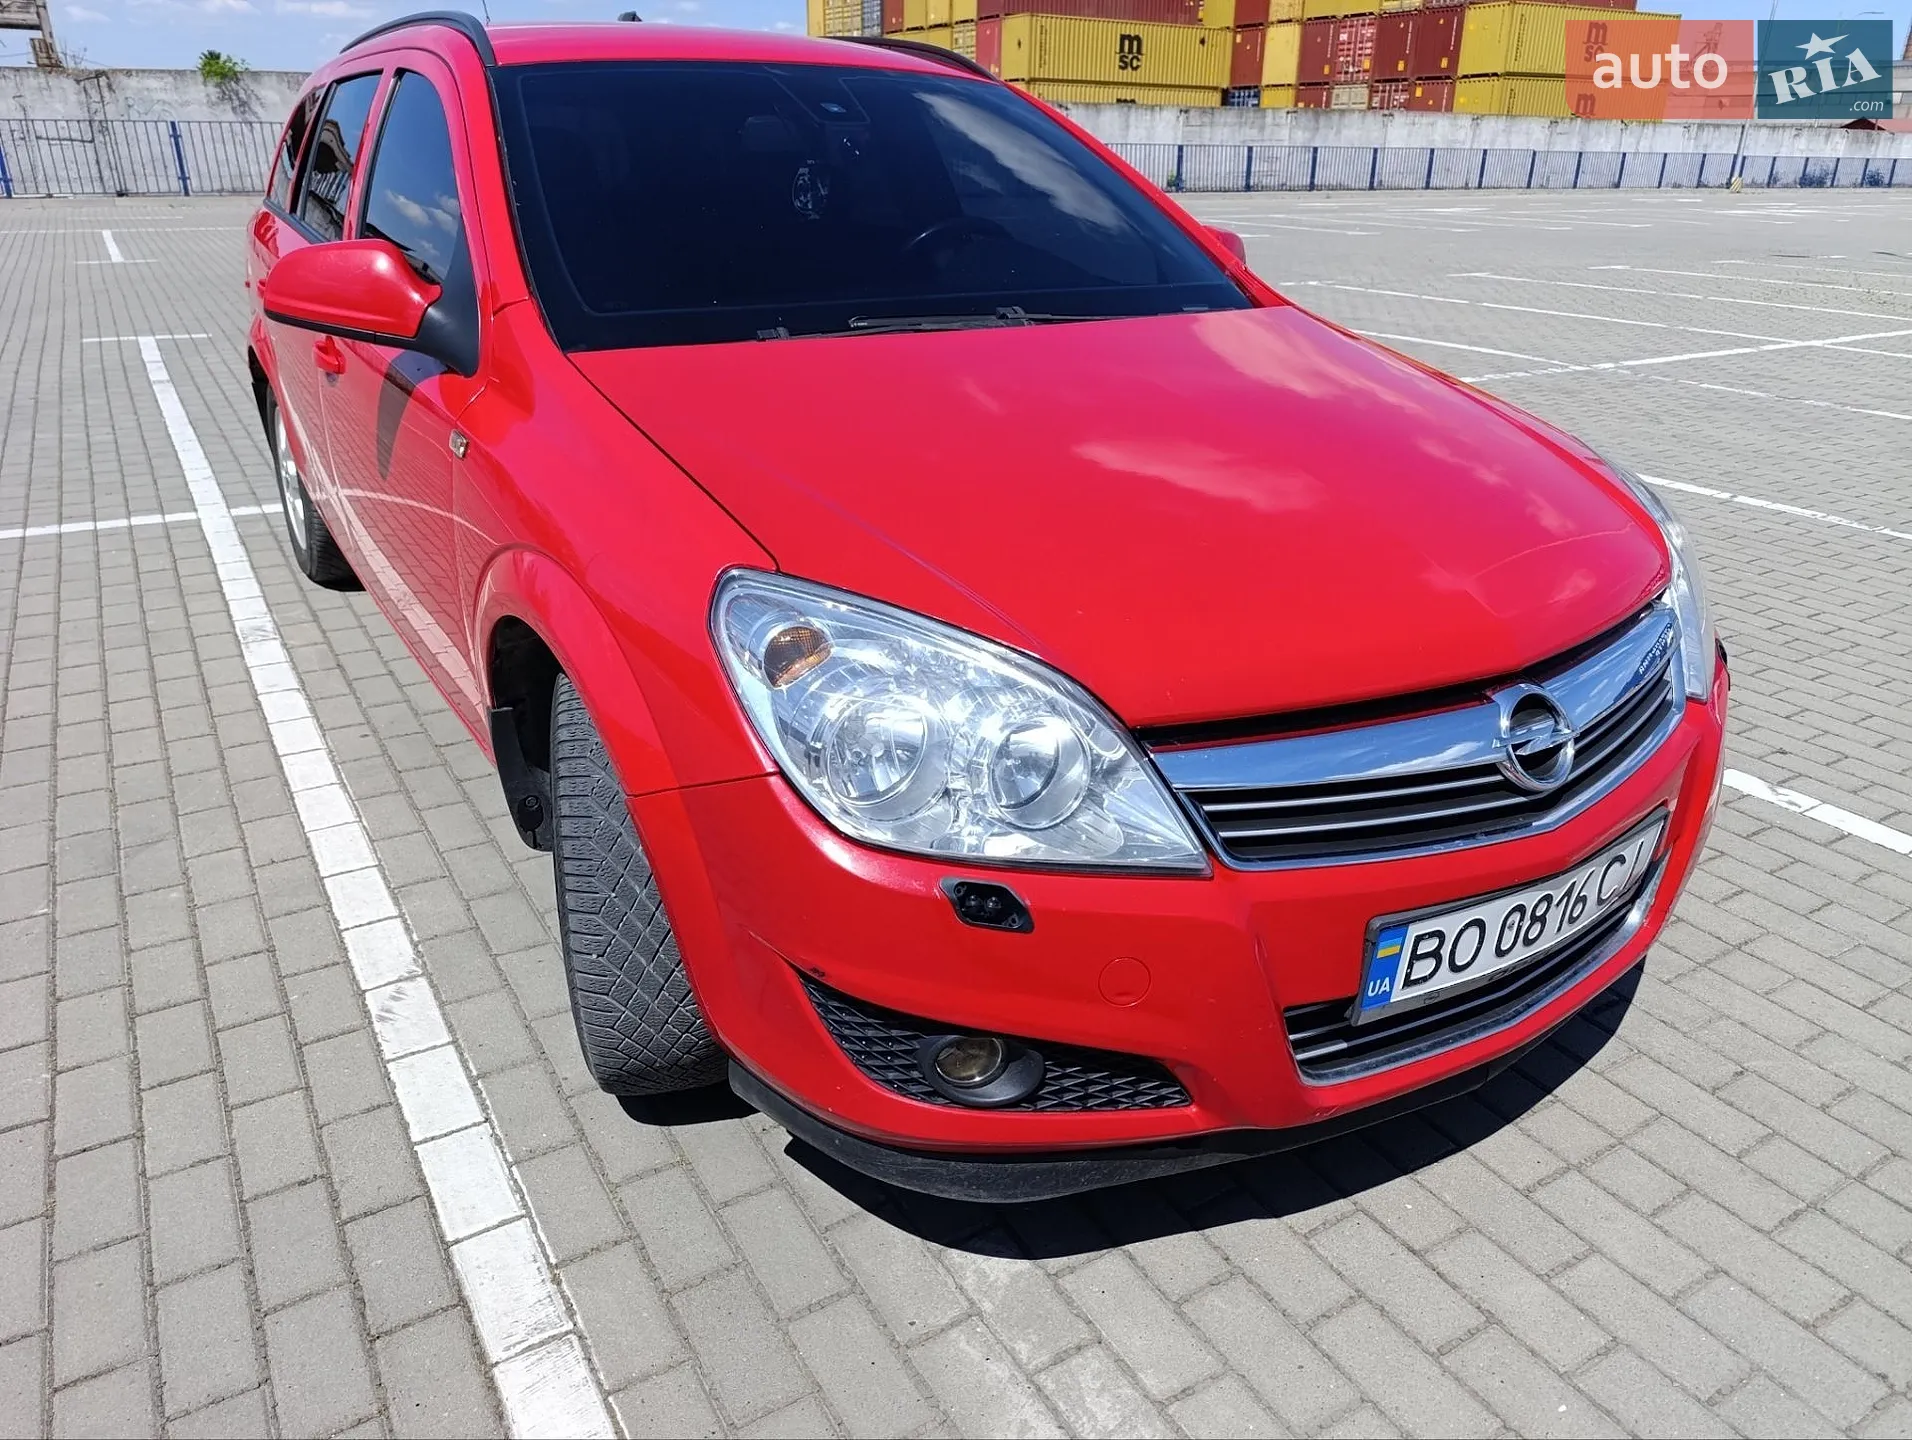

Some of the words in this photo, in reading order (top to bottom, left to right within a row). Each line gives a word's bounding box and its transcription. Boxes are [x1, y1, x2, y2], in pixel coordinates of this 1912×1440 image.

[1402, 919, 1486, 988] BO
[1495, 872, 1592, 956] 0816
[1597, 841, 1645, 904] CI
[1367, 976, 1391, 997] UA
